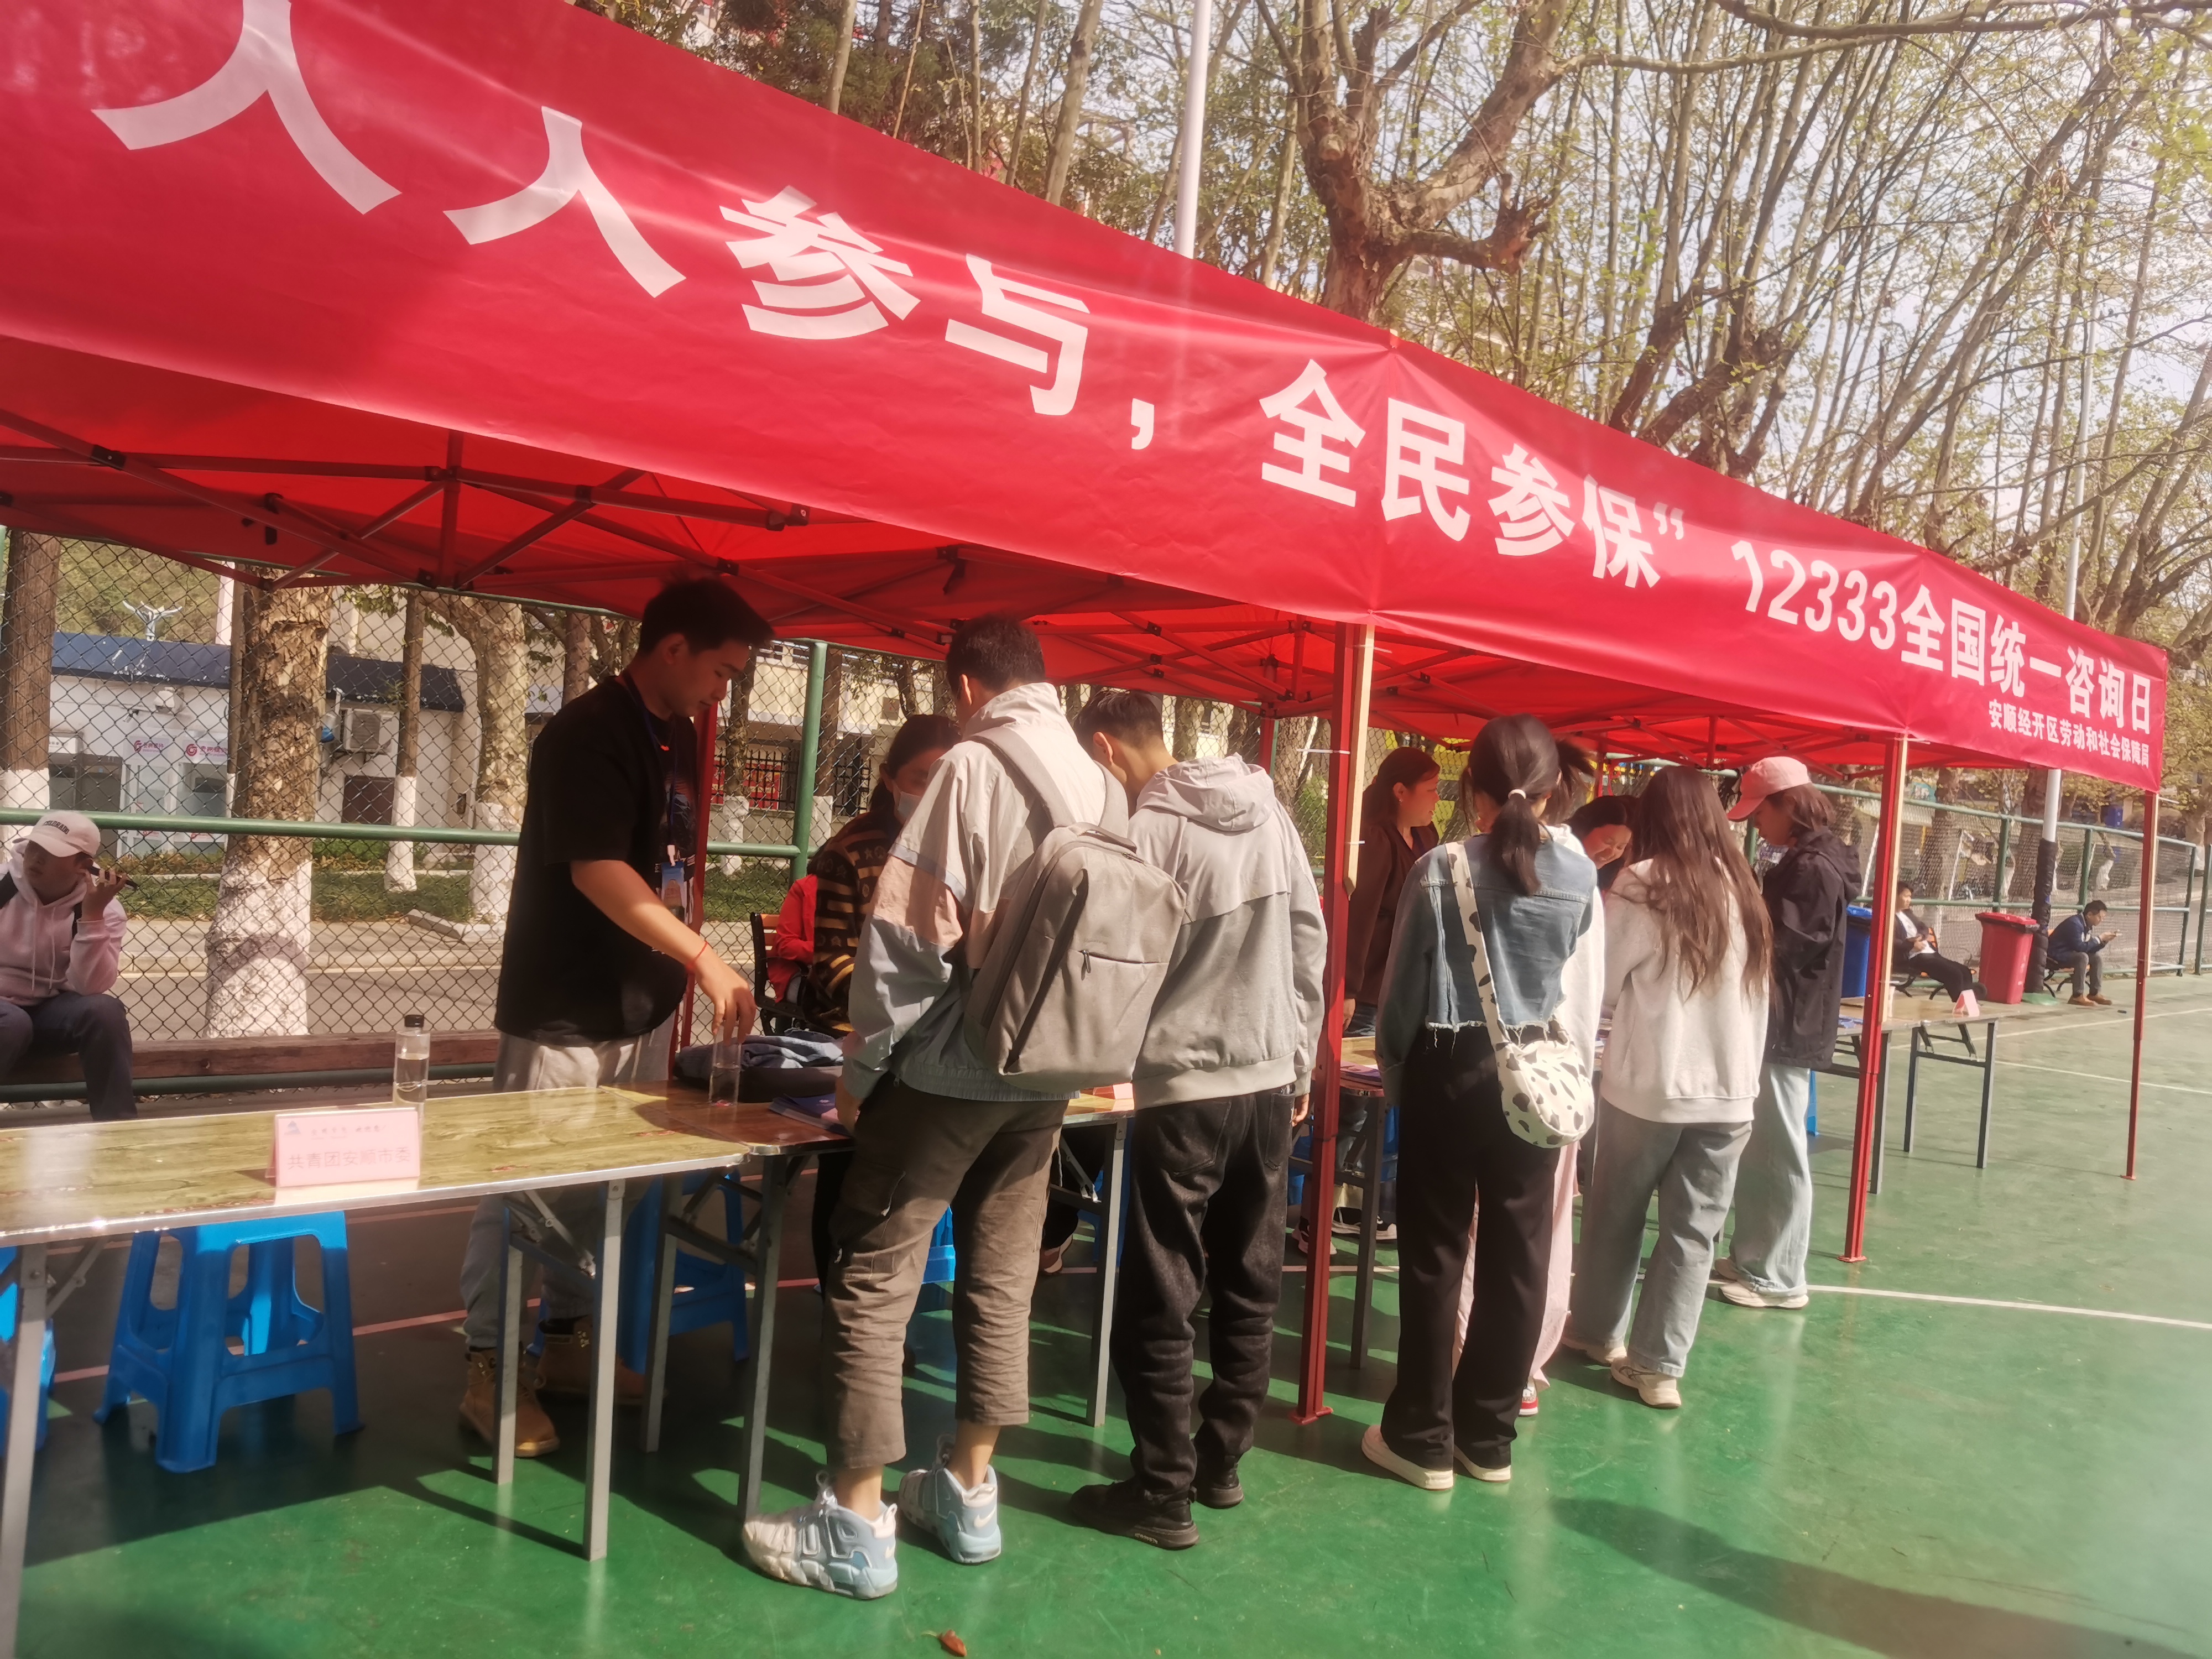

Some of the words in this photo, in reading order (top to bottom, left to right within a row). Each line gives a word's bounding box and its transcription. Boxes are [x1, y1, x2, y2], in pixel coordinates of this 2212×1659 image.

[1731, 540, 2151, 734] 12333全国统一咨询日
[1989, 699, 2150, 768] 安顺经开区劳动和社会保障局
[43, 820, 70, 834] COLORADO
